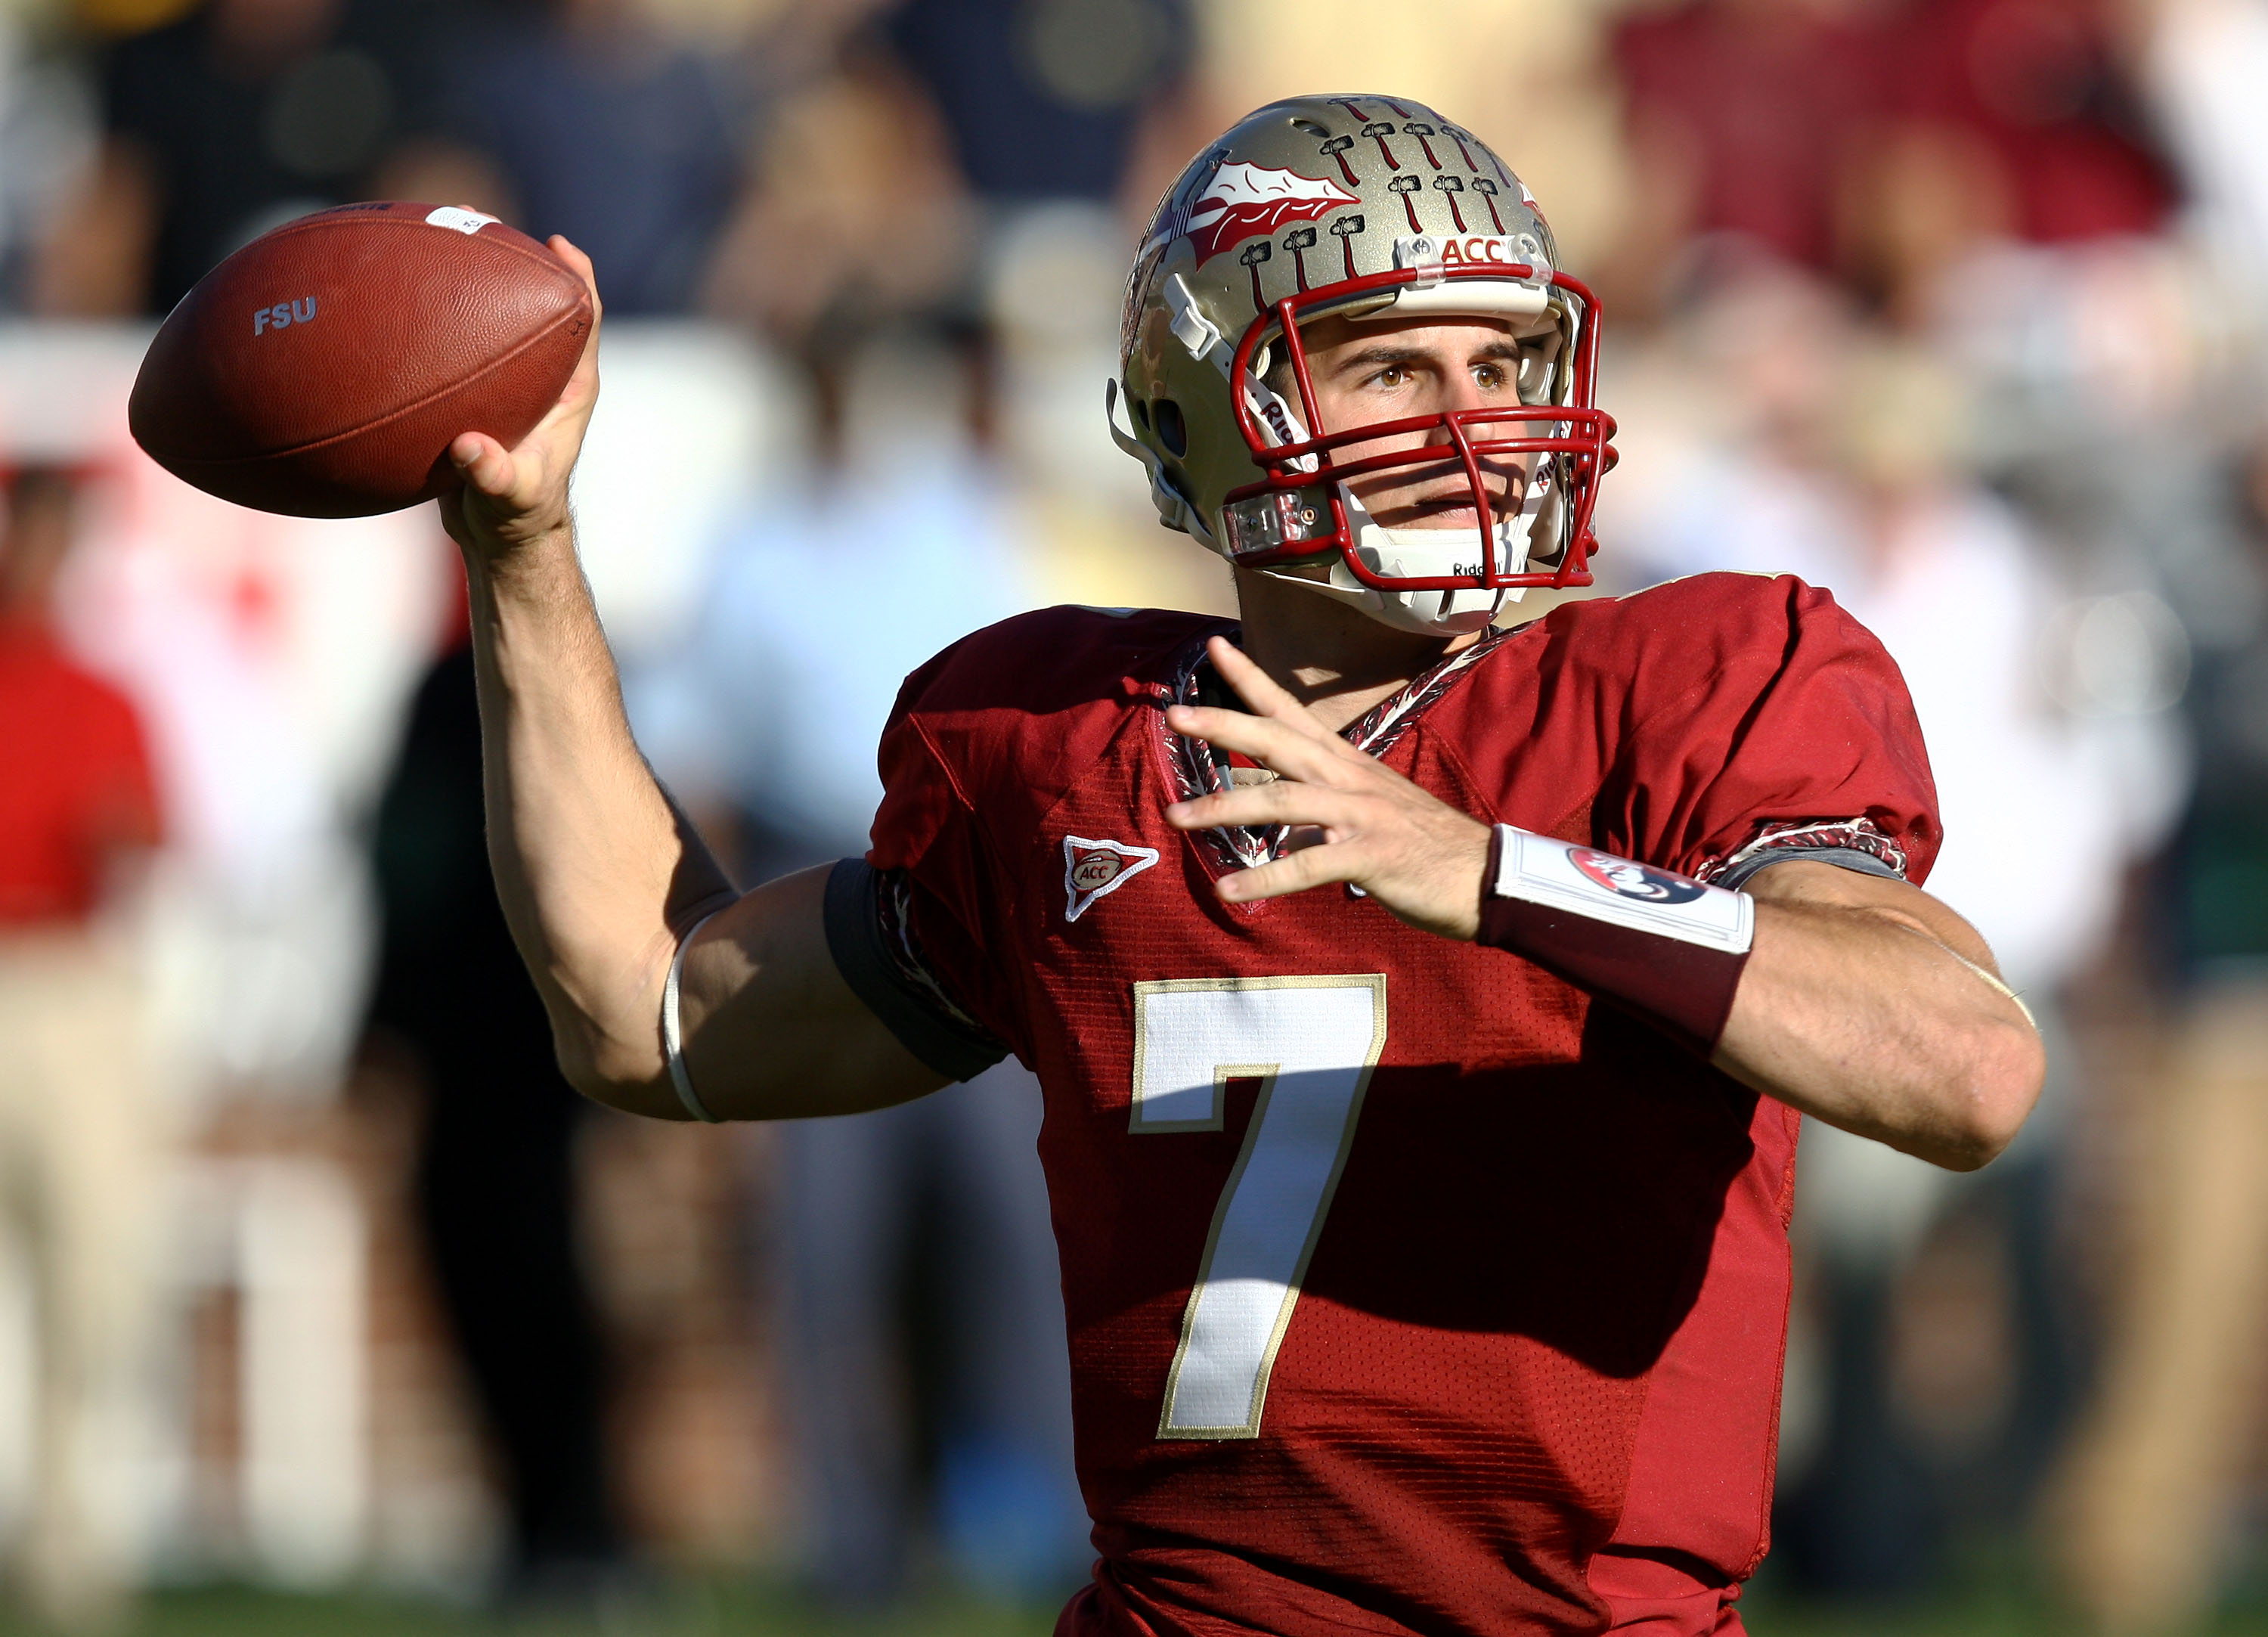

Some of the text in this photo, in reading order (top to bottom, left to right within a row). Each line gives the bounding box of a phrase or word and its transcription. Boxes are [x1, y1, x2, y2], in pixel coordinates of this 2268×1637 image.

[1441, 238, 1503, 263] ACC
[254, 296, 316, 336] FSU
[1080, 865, 1109, 880] ACC
[1128, 974, 1387, 1439] 7
